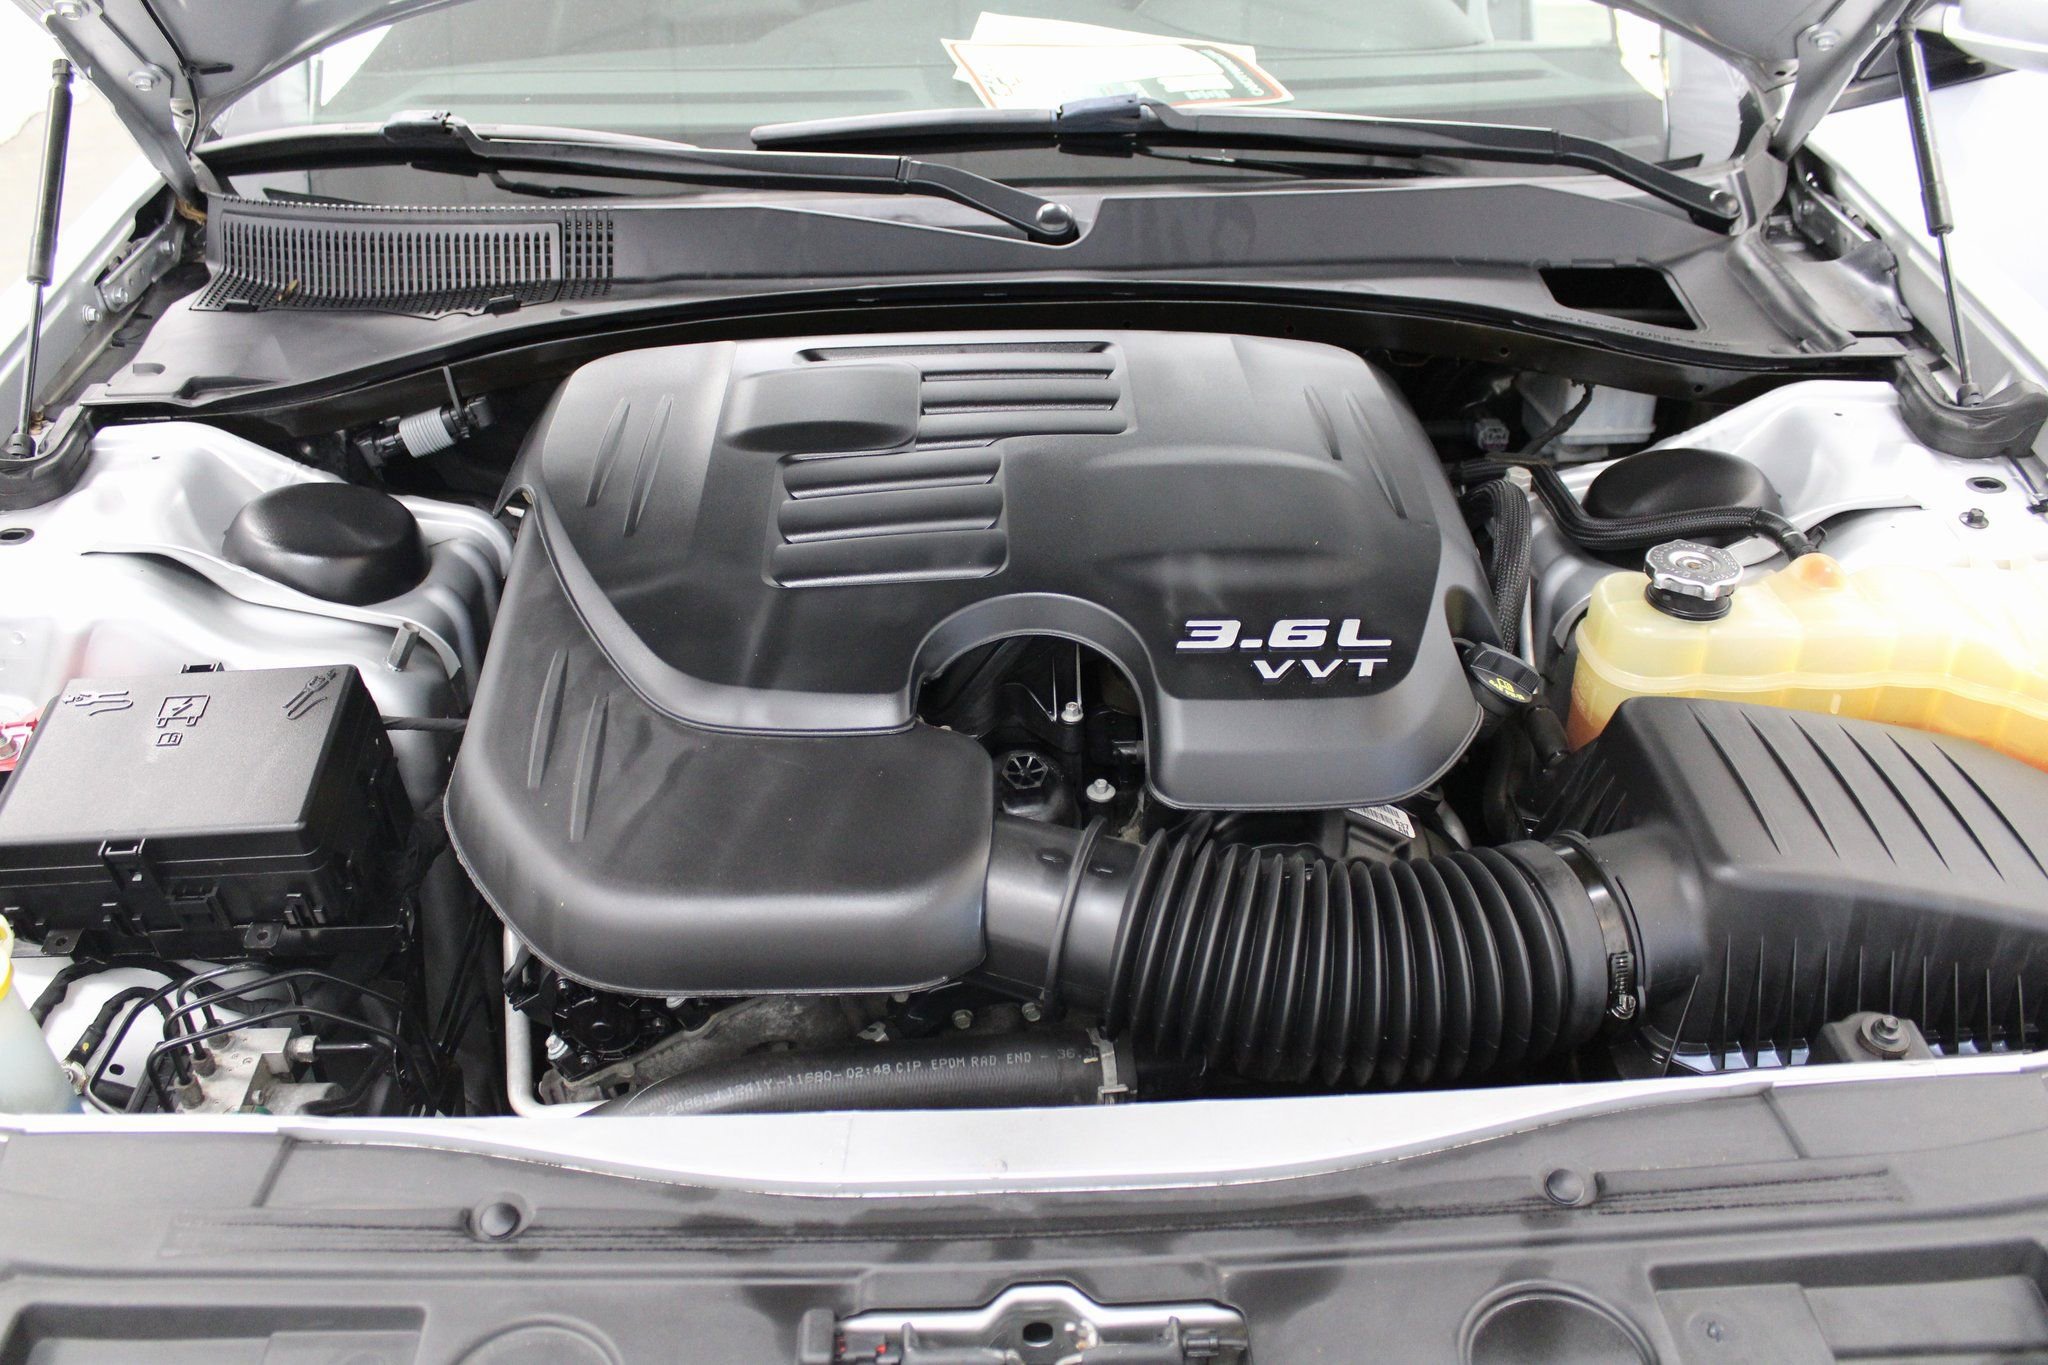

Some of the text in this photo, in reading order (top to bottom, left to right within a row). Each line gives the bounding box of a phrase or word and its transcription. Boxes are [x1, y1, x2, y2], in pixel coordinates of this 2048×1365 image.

[1176, 618, 1392, 650] 3.6L
[1253, 658, 1388, 681] VVT
[896, 1060, 921, 1074] CIP
[931, 1056, 965, 1071] EPDM
[971, 1053, 997, 1068] RAD
[1006, 1051, 1032, 1065] END
